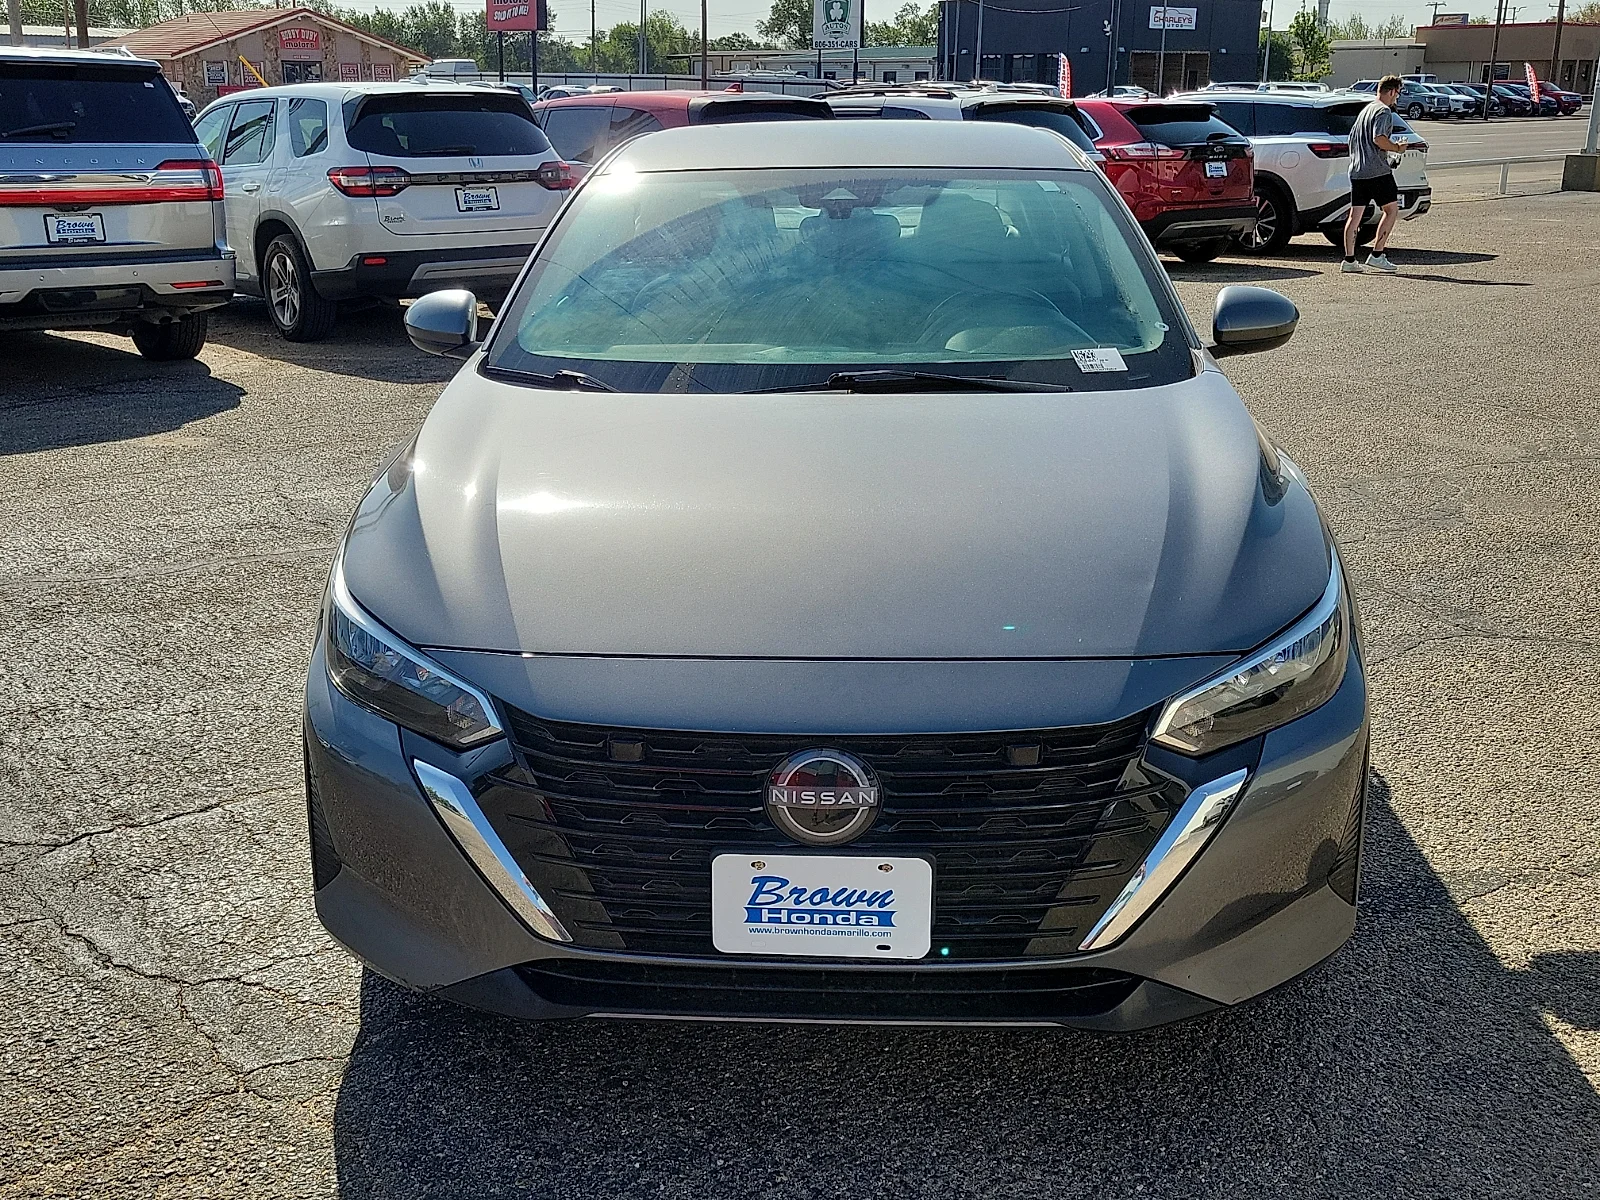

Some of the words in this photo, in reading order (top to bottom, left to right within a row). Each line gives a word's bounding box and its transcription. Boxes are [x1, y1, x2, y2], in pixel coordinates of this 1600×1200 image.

[56, 220, 95, 229] Brown
[771, 788, 876, 805] NISSAN
[747, 875, 896, 909] Brown
[761, 908, 879, 926] Honda
[748, 926, 892, 938] www.brownhondaamarillo.com
